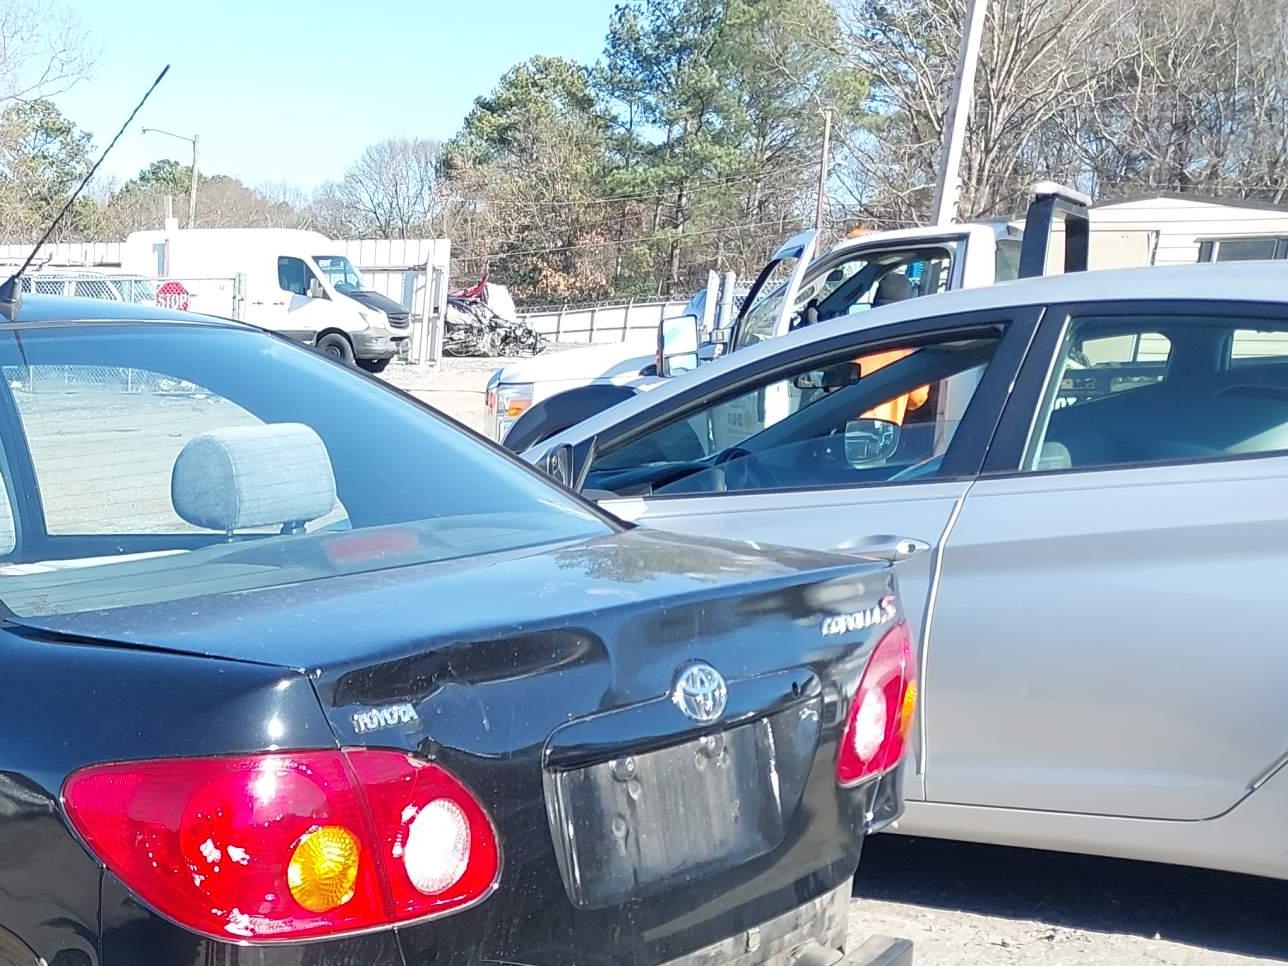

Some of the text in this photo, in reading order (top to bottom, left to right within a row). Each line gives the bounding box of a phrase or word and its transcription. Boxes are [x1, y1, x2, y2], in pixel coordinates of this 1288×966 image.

[158, 293, 190, 309] STOP
[821, 595, 896, 636] COROLLA S
[353, 703, 418, 733] TOYOTA
